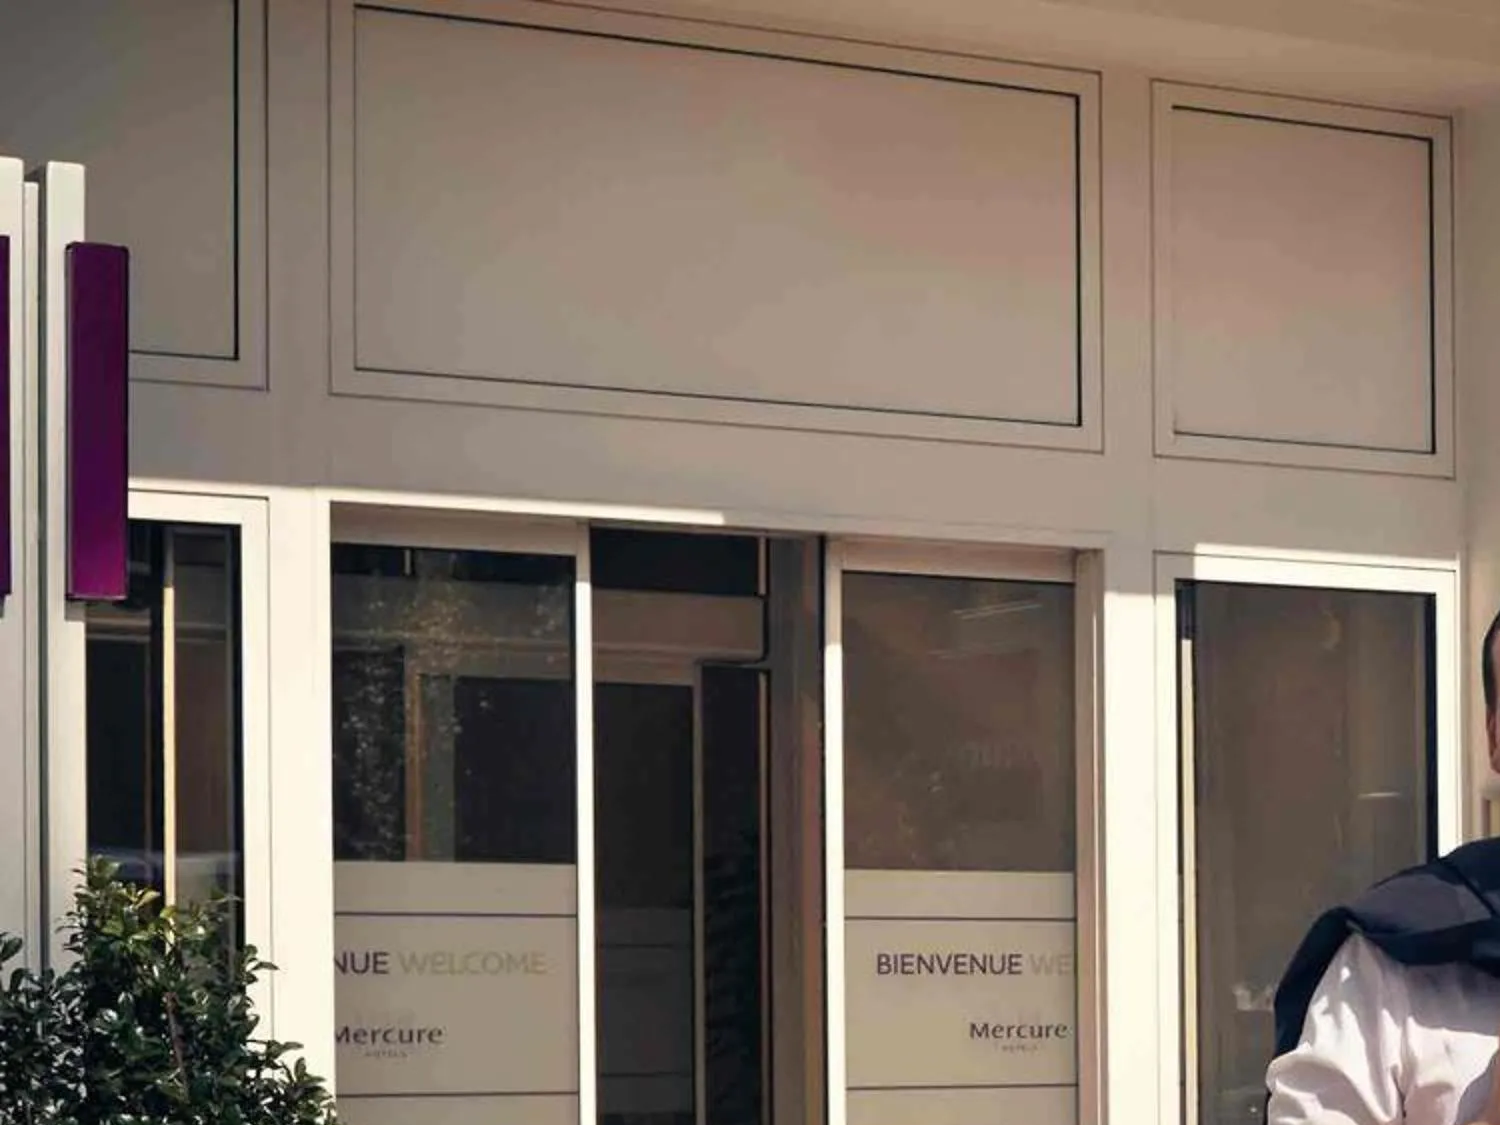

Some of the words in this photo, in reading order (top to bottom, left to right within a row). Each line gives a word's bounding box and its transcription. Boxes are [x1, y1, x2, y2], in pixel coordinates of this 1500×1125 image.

[334, 950, 391, 976] NUE
[400, 951, 548, 976] WELCOME
[876, 952, 1023, 976] BIENVENUE
[1028, 953, 1073, 977] WE
[335, 1024, 444, 1045] Mercure
[969, 1021, 1068, 1040] Mercure
